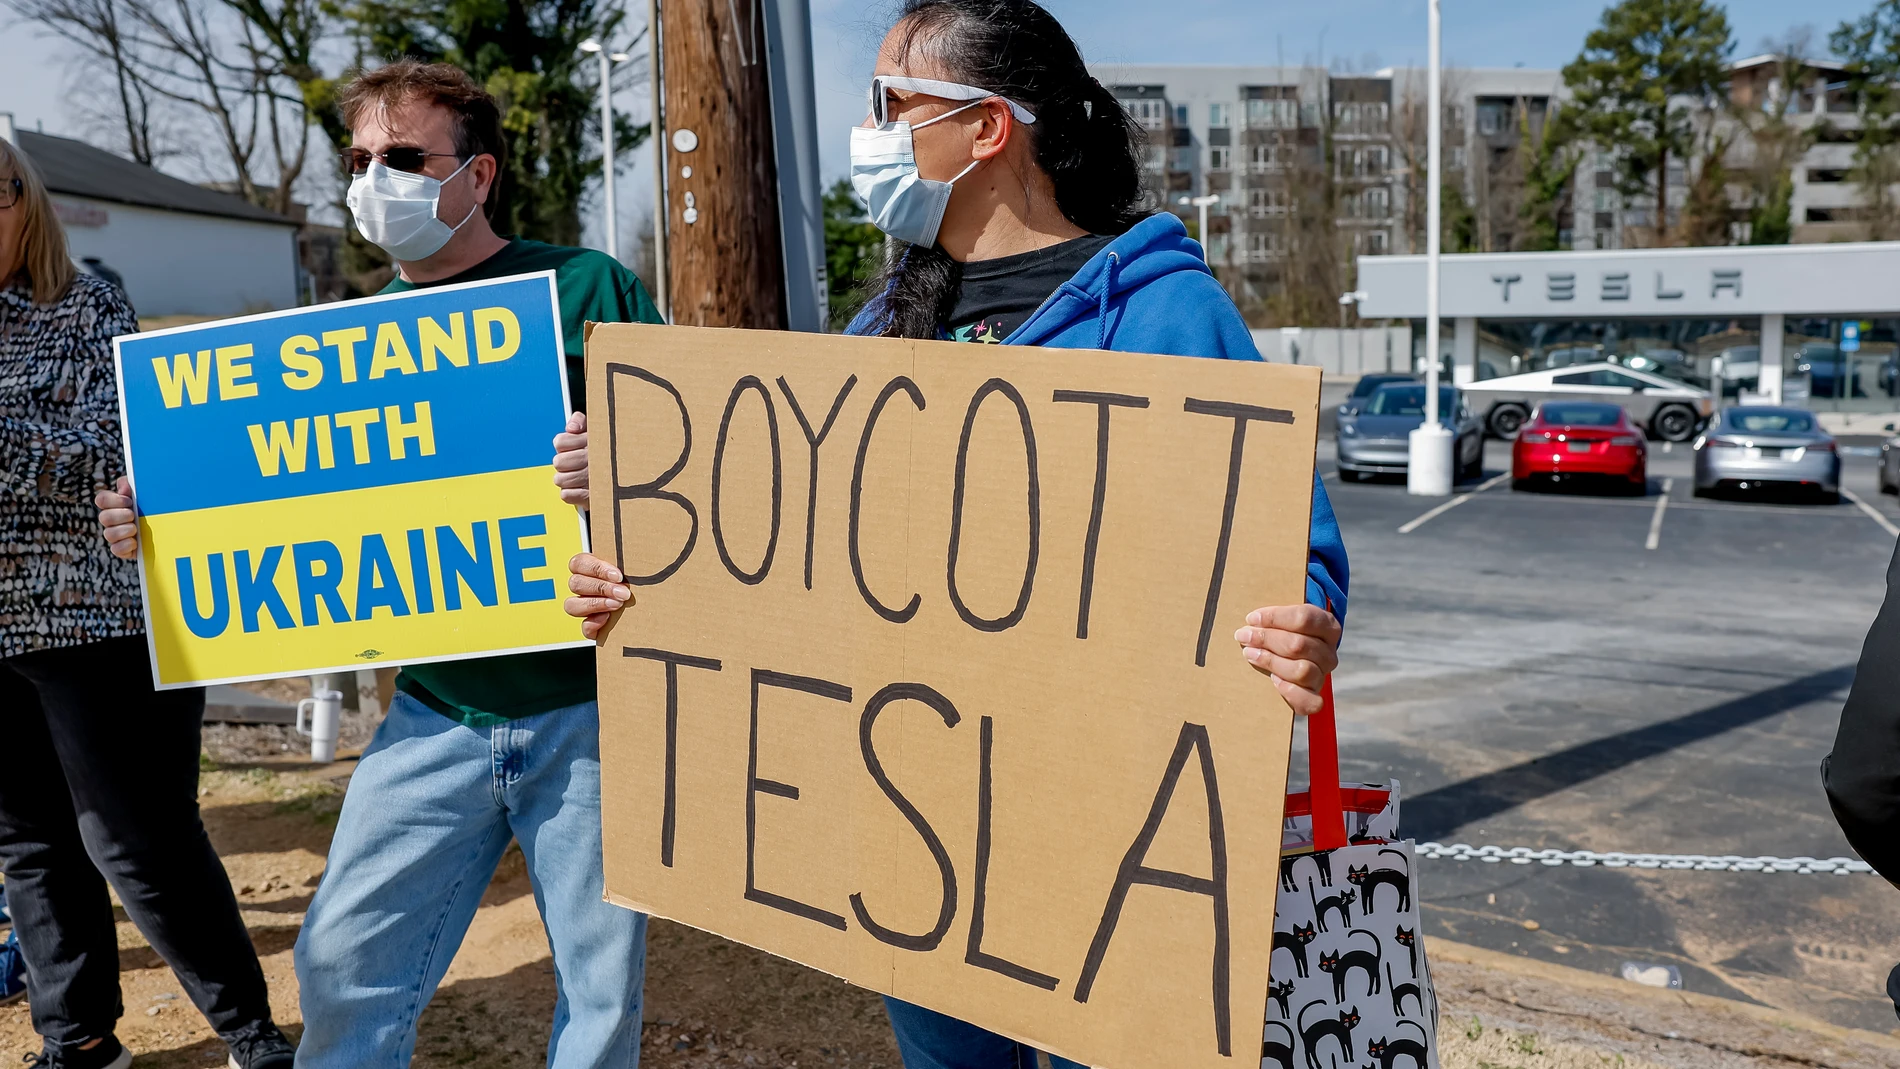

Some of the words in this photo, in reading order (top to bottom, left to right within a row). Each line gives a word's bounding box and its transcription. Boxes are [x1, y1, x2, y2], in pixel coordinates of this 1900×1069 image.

[1490, 269, 1744, 304] TESLA
[152, 343, 258, 409] WE
[280, 306, 521, 390] STAND
[247, 401, 436, 477] WITH
[605, 361, 1296, 669] BOYCOTT
[174, 513, 557, 640] UKRAINE
[621, 645, 1233, 1058] TESLA
